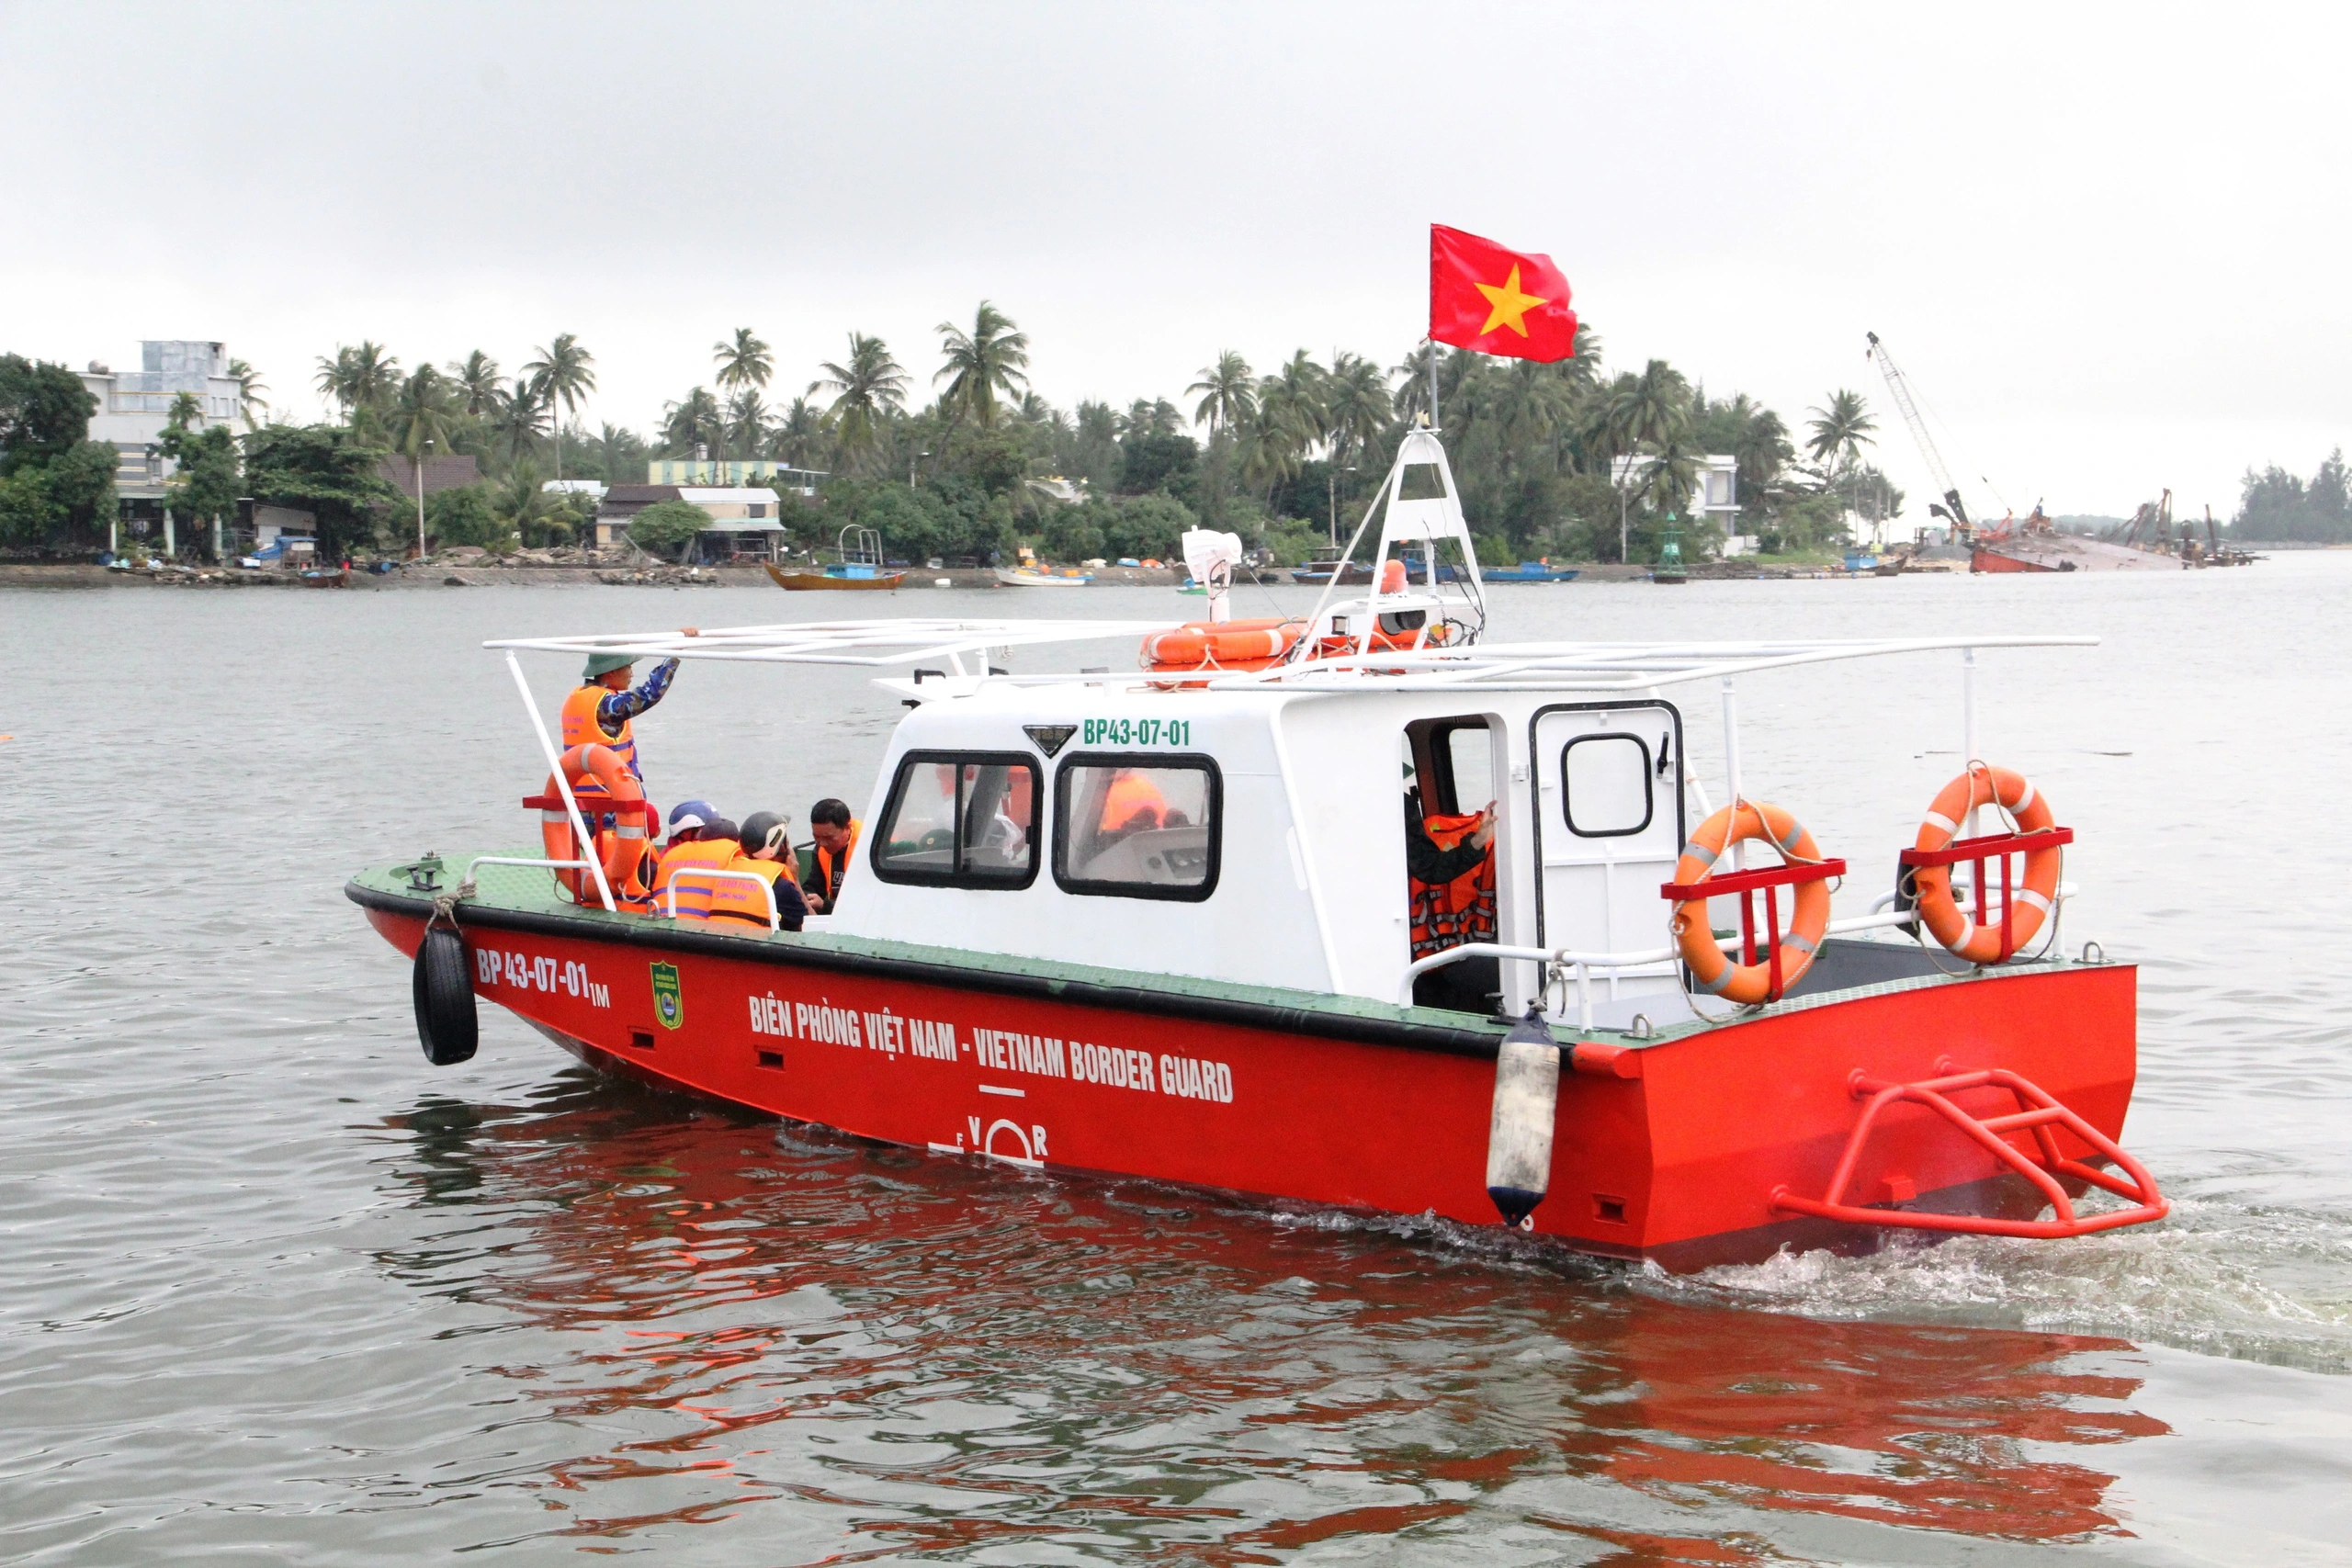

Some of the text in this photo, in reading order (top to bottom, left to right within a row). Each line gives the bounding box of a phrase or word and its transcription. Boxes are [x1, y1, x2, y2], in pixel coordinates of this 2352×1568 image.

[1084, 719, 1190, 746] BP43-07-01
[476, 948, 590, 998] BP 43-07-01
[589, 982, 610, 1009] 1M
[749, 990, 793, 1038] BIÊN
[796, 997, 862, 1048] PHÒNG
[864, 1007, 905, 1061] VIỆT
[909, 1019, 957, 1062] NAM
[973, 1027, 1067, 1078] VIETNAM
[1069, 1041, 1156, 1093] BORDER
[1159, 1054, 1234, 1104] GUARD
